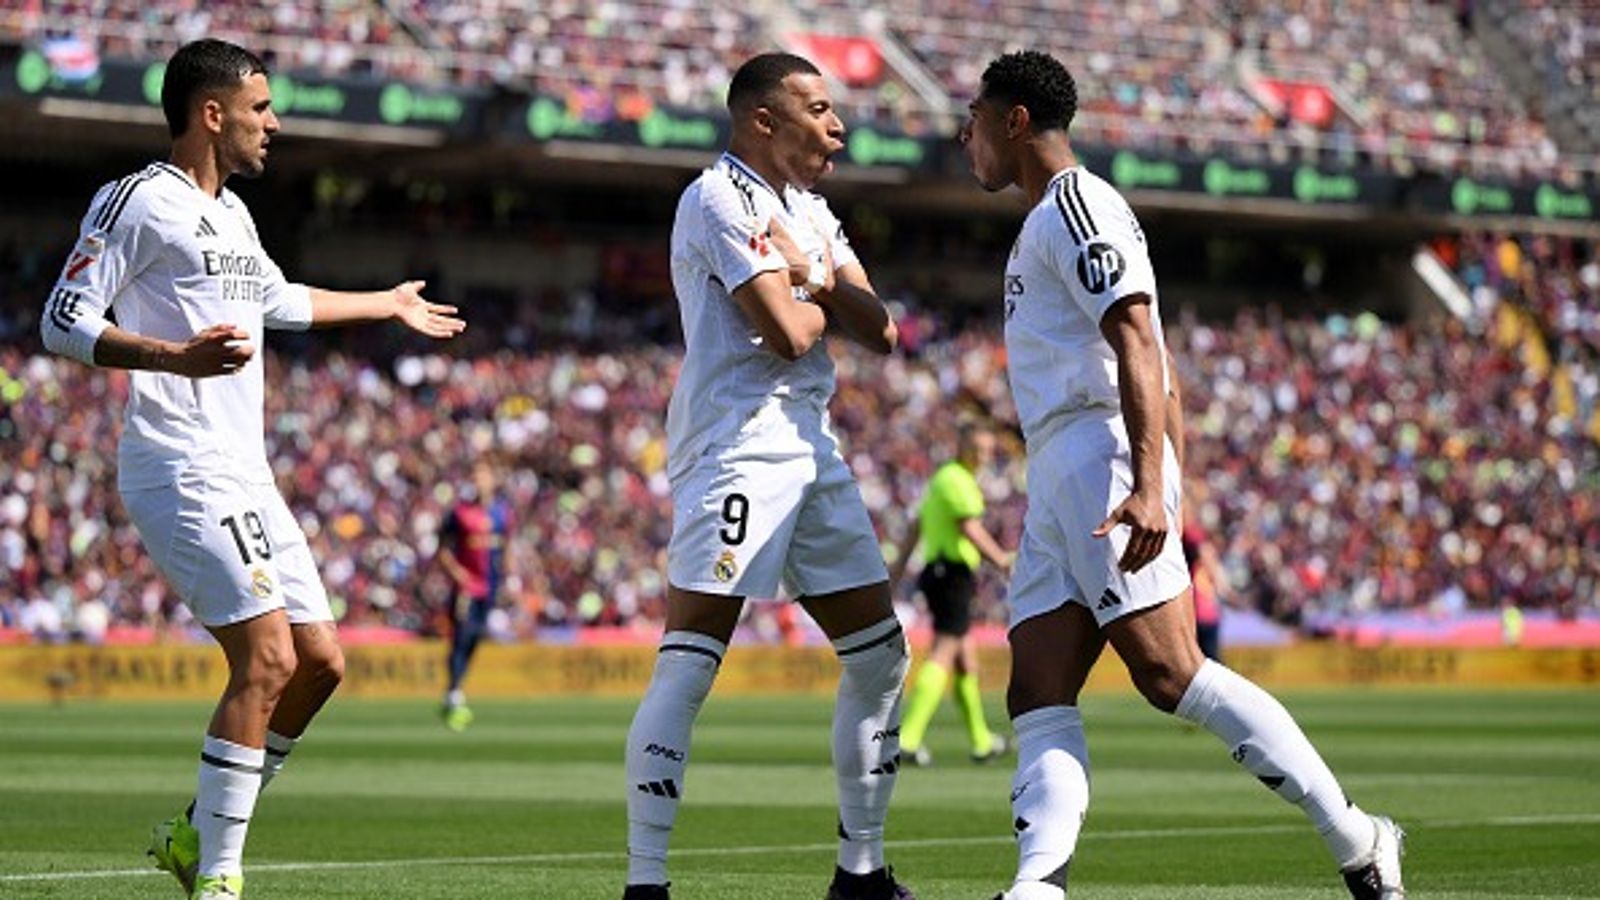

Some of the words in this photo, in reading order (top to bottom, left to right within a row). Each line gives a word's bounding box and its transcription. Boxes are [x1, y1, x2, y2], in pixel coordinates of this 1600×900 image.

[201, 248, 269, 279] Emira
[1083, 245, 1120, 292] hp
[220, 510, 272, 567] 19
[719, 493, 749, 546] 9
